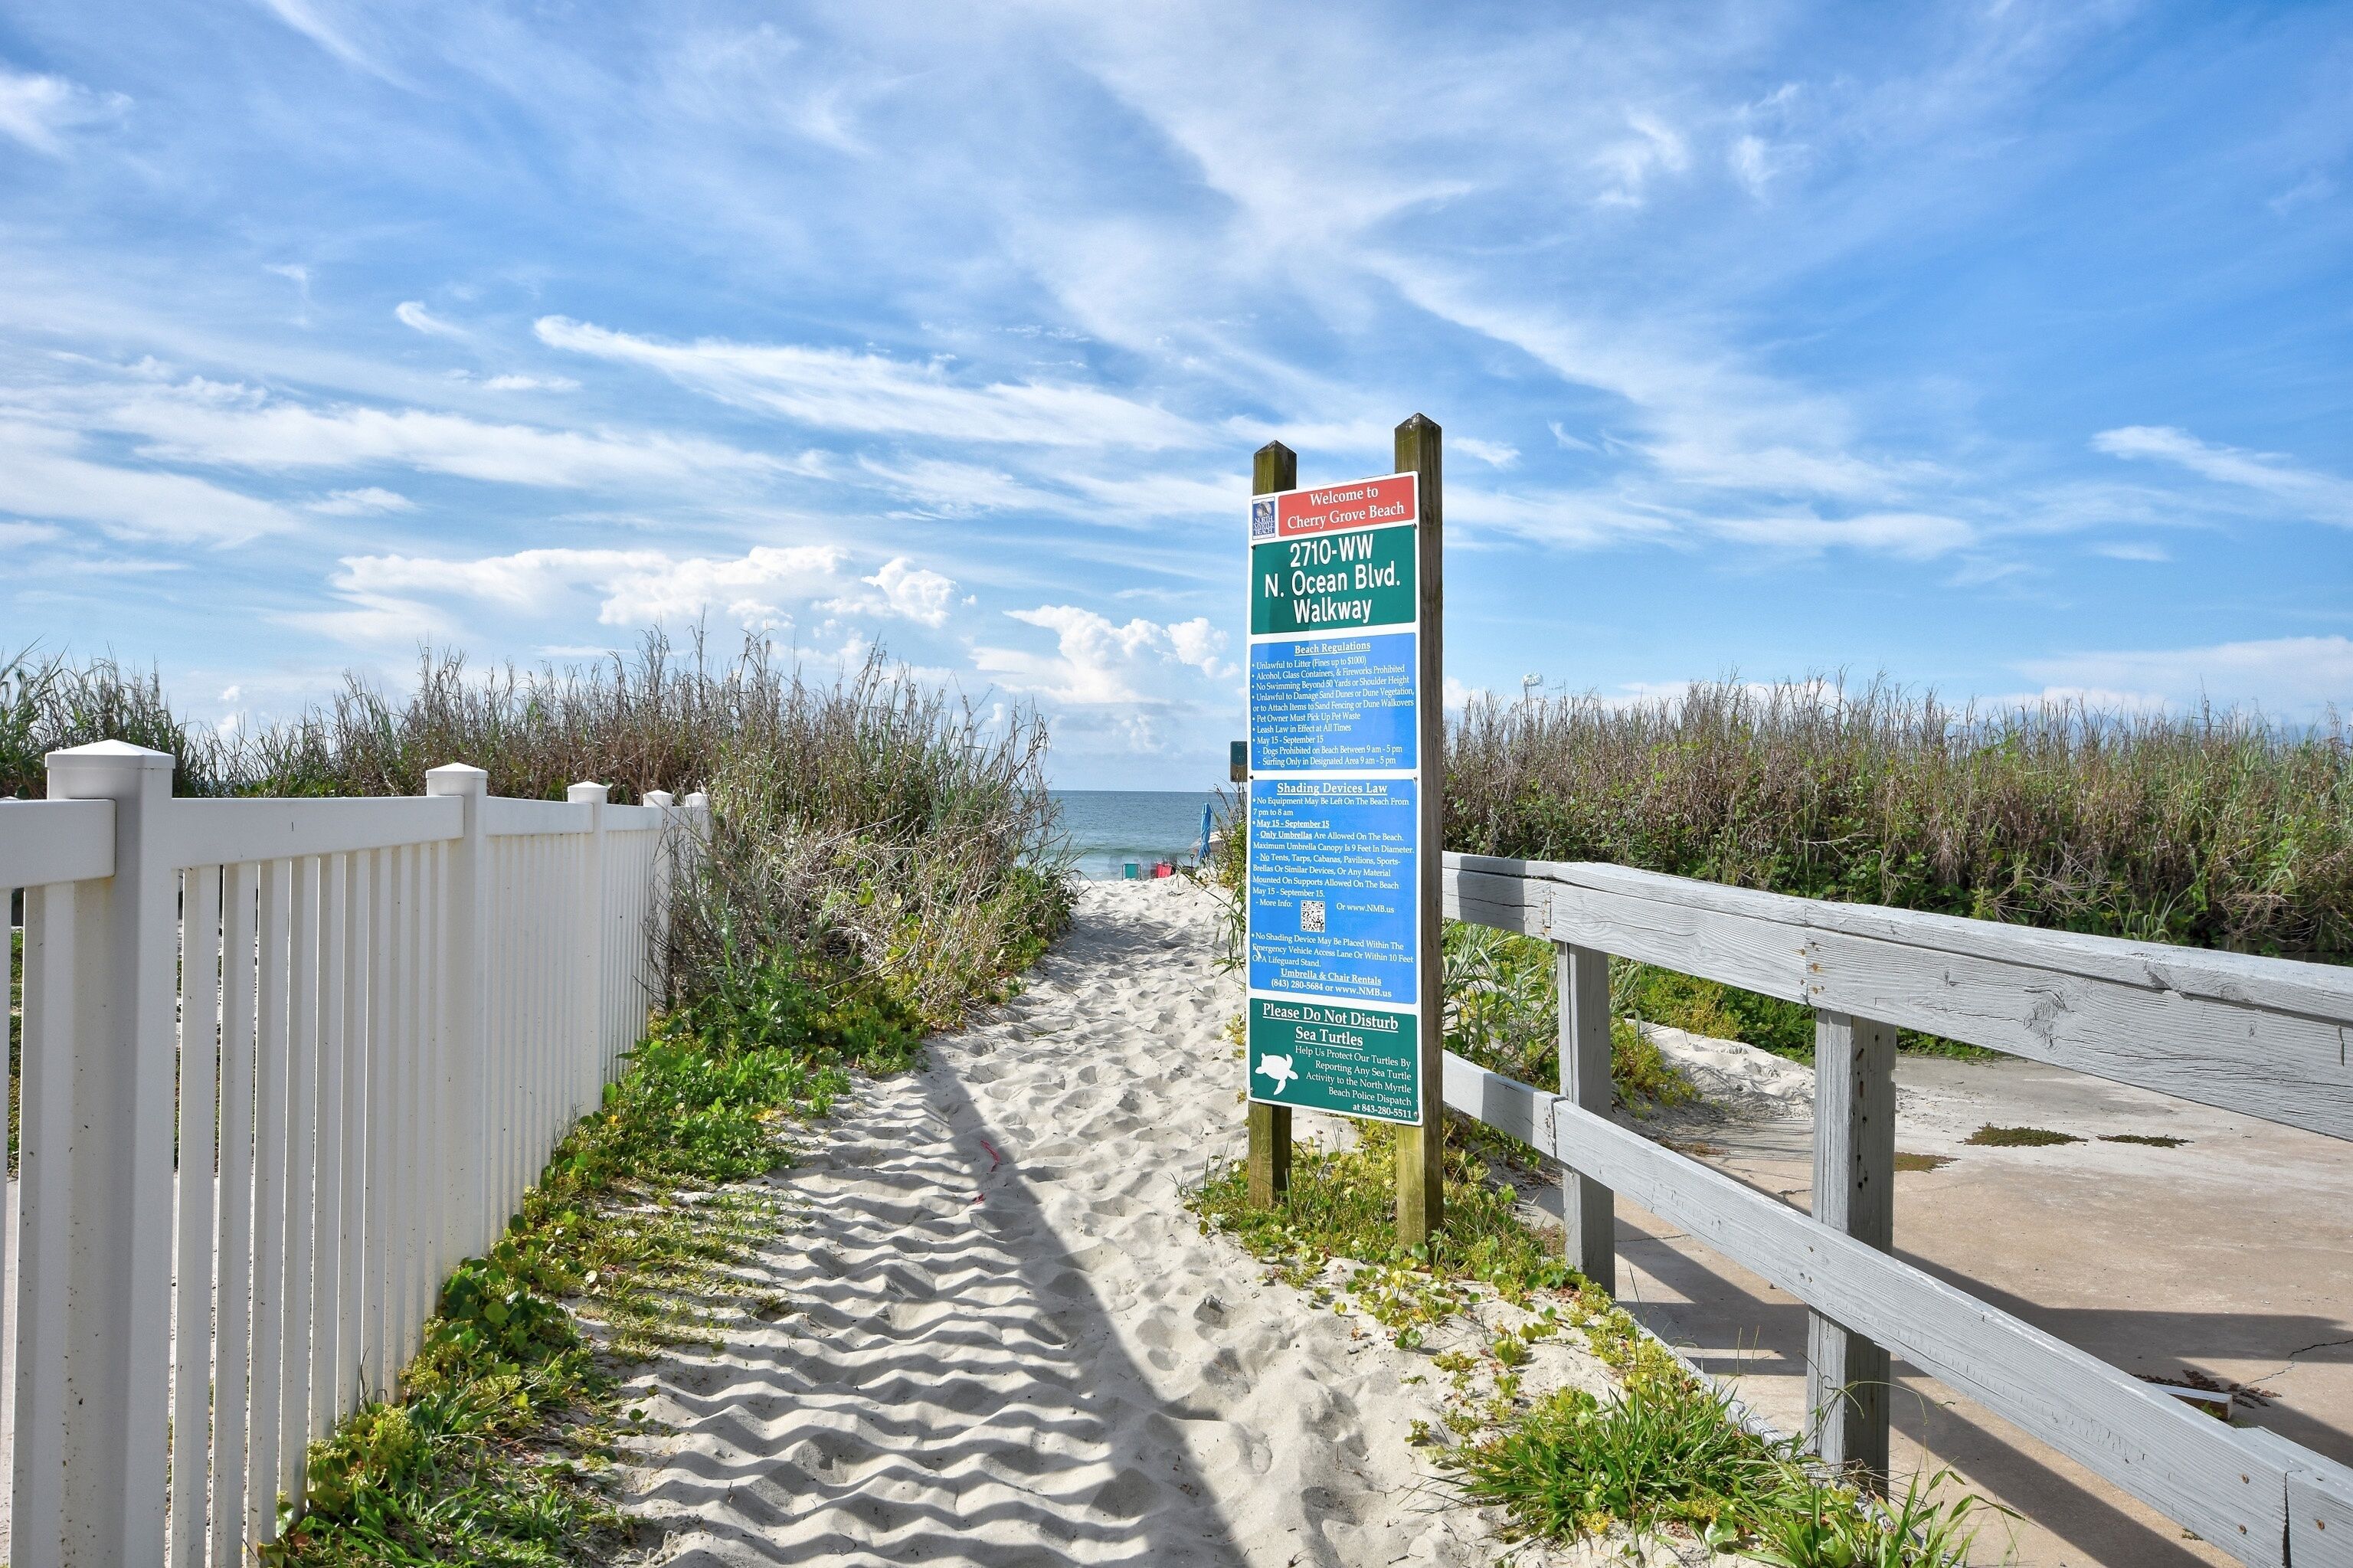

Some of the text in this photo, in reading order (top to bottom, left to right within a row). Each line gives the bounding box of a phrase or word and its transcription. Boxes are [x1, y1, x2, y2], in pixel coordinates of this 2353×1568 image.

[1310, 486, 1378, 506] Welcome to
[1288, 502, 1405, 529] Cherry Grove Beach
[1290, 534, 1373, 567] 2710-WW
[1265, 561, 1400, 597] N. Ocean Blvd.
[1294, 597, 1372, 624] Walkway
[1294, 642, 1370, 654] Beach Regulations
[1257, 660, 1285, 669] Unlawful
[1312, 659, 1330, 667] (Fines
[1343, 667, 1372, 676] Fireworks
[1373, 665, 1405, 674] Prohibited
[1267, 682, 1300, 690] Swimming
[1302, 680, 1324, 689] Beyond
[1360, 677, 1386, 686] Shoulder
[1389, 676, 1409, 686] Height
[1257, 692, 1284, 701] Unlawful
[1294, 692, 1318, 700] Damage
[1380, 687, 1414, 696] Vegetation,
[1331, 702, 1354, 710] Fencing
[1321, 713, 1330, 722] Up
[1257, 737, 1269, 745] May
[1283, 736, 1315, 745] September
[1263, 747, 1278, 756] Dogs
[1263, 758, 1284, 767] Surfing
[1286, 758, 1301, 766] Only
[1311, 757, 1343, 766] Designated
[1277, 783, 1387, 795] Shading Devices Law
[1268, 797, 1302, 806] Equipment
[1304, 797, 1319, 806] May
[1257, 820, 1271, 828] May
[1260, 831, 1277, 840] Only
[1318, 843, 1343, 853] Canopy
[1292, 855, 1311, 863] Tarps,
[1377, 857, 1400, 866] Sports-
[1348, 869, 1361, 877] Any
[1294, 878, 1323, 886] Supports
[1253, 888, 1266, 896] May
[1347, 905, 1394, 913] www.NMB.us
[1266, 933, 1292, 944] Shading
[1294, 935, 1316, 944] Device
[1317, 937, 1331, 946] May
[1366, 941, 1389, 949] Within
[1253, 944, 1286, 954] Emergency
[1288, 947, 1312, 955] Vehicle
[1314, 948, 1335, 957] Access
[1337, 950, 1352, 958] Lane
[1365, 952, 1387, 961] Within
[1399, 954, 1413, 963] Feet
[1268, 957, 1321, 967] Lifeguard Stand.
[1281, 969, 1382, 985] Umbrella Chair Rentals
[1271, 980, 1391, 997] (843) 280-5684 www.NMB.us
[1263, 1003, 1398, 1030] Please Do Not Disturb
[1295, 1026, 1363, 1046] Sea Turtles
[1295, 1046, 1313, 1057] Help
[1327, 1049, 1352, 1060] Protect
[1354, 1053, 1370, 1062] Our
[1371, 1055, 1398, 1066] Turtles
[1401, 1059, 1411, 1069] By
[1316, 1061, 1411, 1080] Reporting Any Sea Turtle
[1306, 1072, 1412, 1093] Activity the North Myrtle
[1329, 1087, 1412, 1106] Beach Police Dispatch
[1362, 1104, 1412, 1118] 843-280-5511
